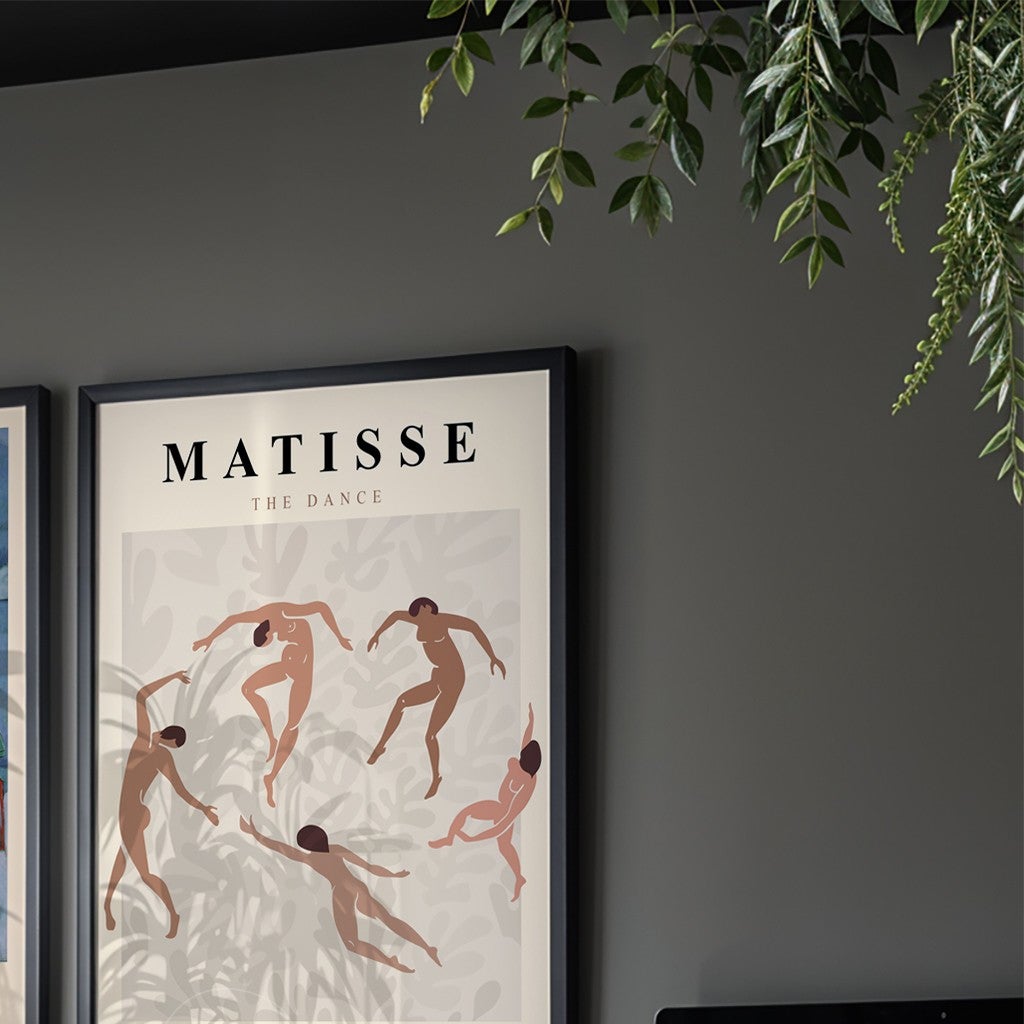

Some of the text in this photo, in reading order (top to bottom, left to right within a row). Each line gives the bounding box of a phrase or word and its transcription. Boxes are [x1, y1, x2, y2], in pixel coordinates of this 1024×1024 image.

[162, 421, 476, 483] MATISSE
[251, 489, 382, 511] THE DANCE
